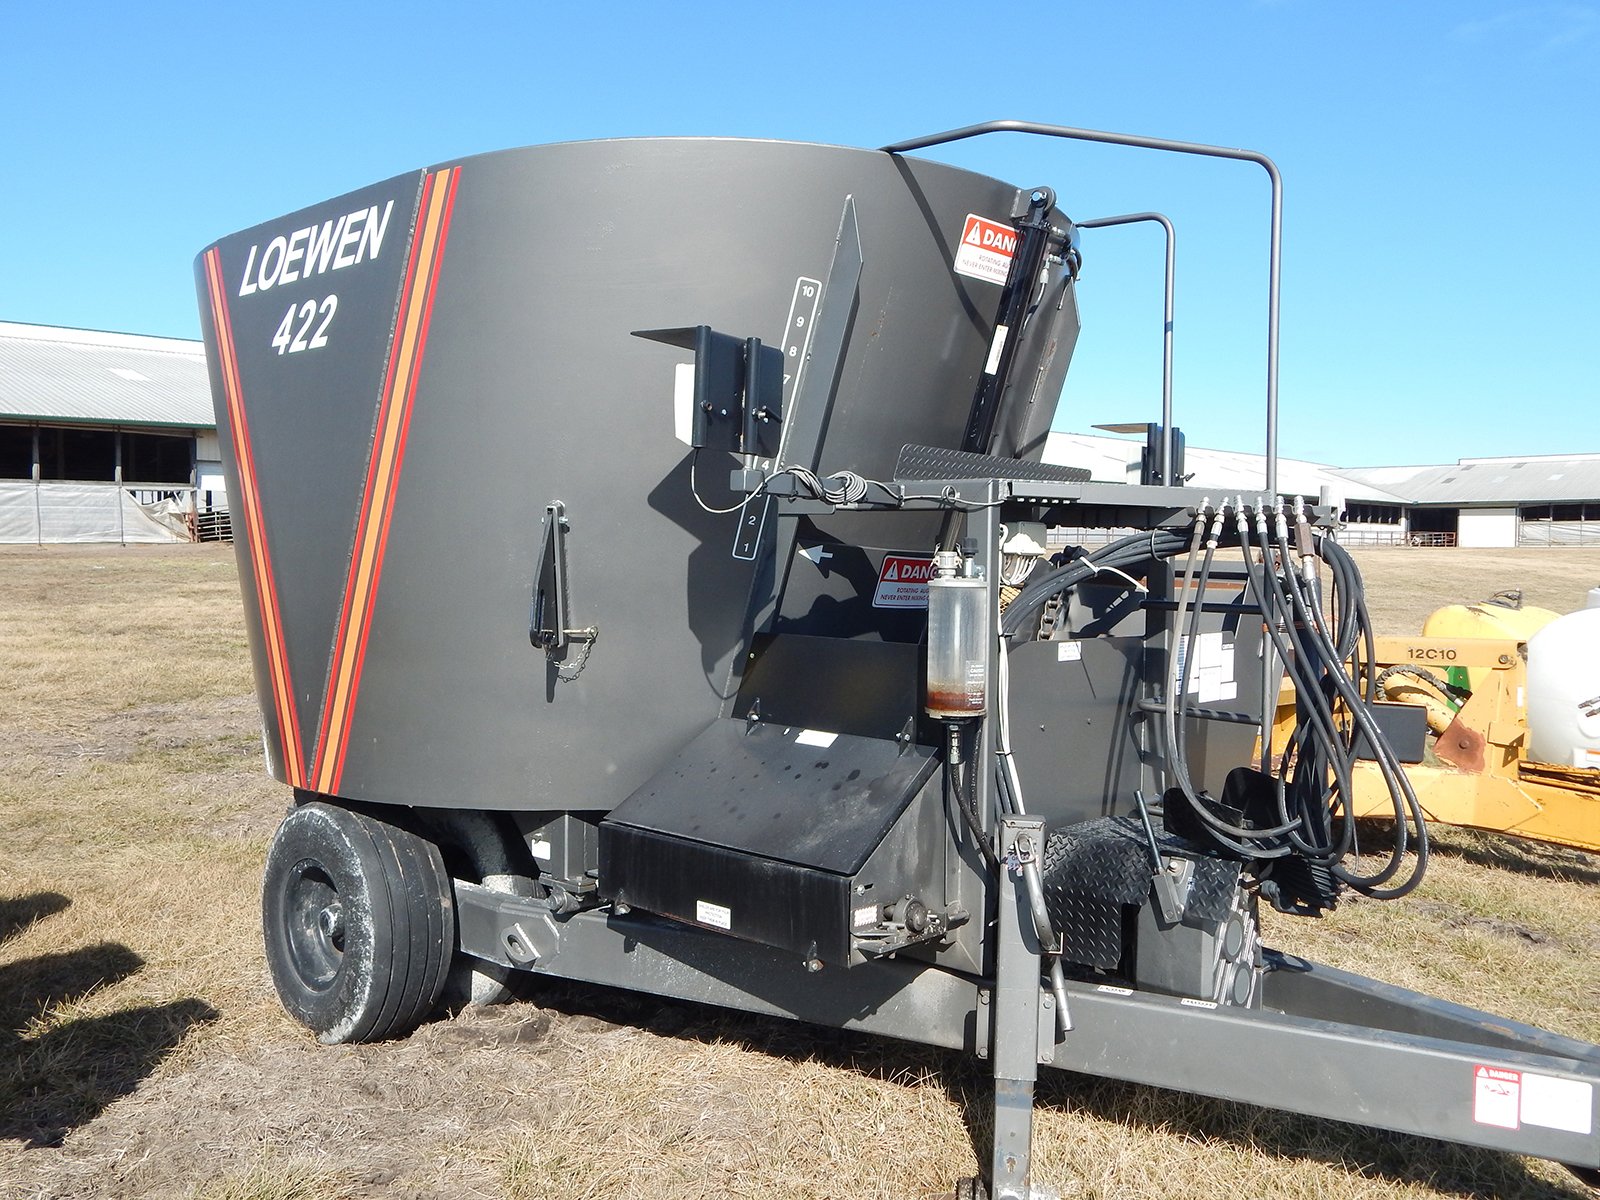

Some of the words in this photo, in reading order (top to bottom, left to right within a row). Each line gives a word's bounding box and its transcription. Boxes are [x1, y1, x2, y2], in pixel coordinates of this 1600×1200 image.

[239, 200, 395, 297] LOEWEN
[962, 259, 978, 268] NEVER
[979, 265, 993, 273] ENTER
[802, 285, 814, 298] 10
[272, 294, 338, 356] 422
[796, 316, 804, 328] 9
[789, 346, 797, 357] 8
[783, 374, 791, 385] 7
[762, 460, 769, 471] 4
[748, 515, 756, 526] 2
[744, 543, 749, 552] 1
[1408, 648, 1456, 660] 12C10
[1489, 1069, 1519, 1081] DANGER
